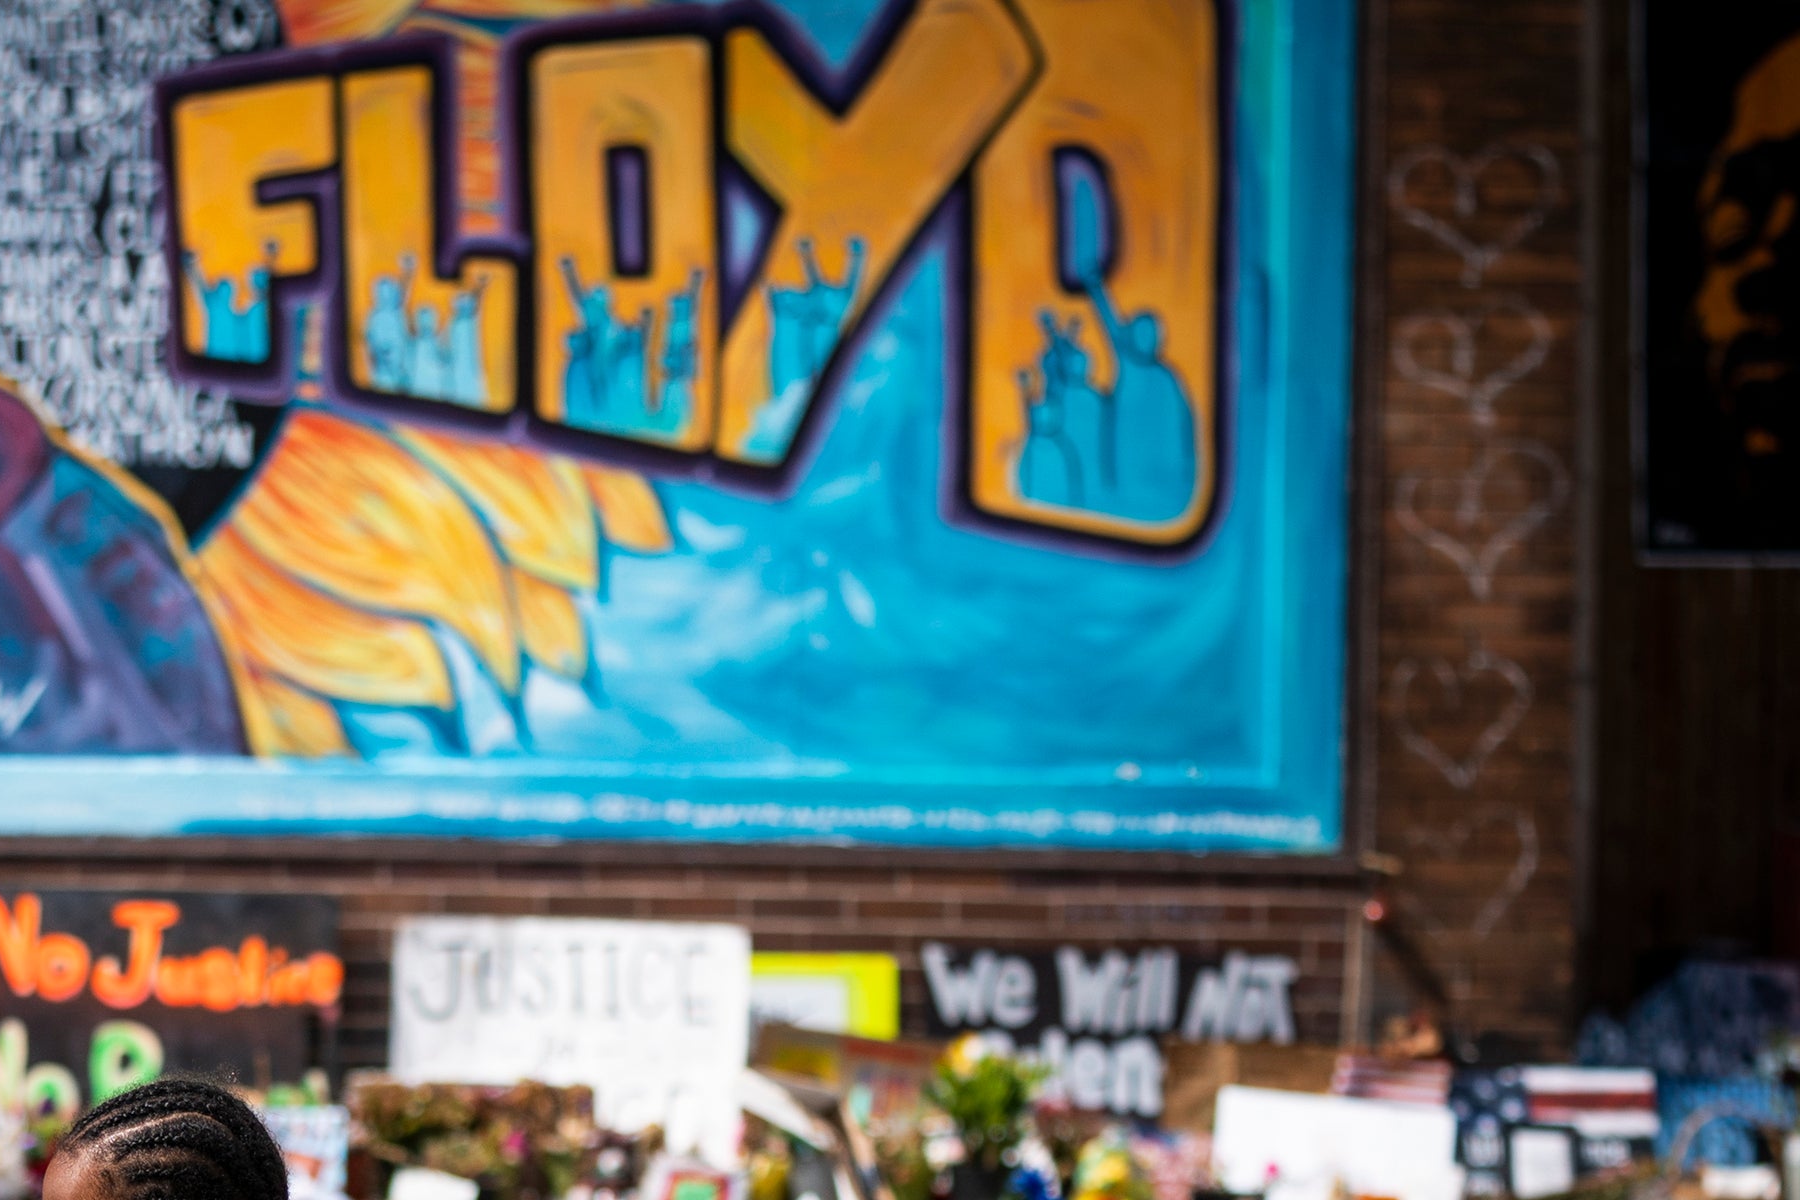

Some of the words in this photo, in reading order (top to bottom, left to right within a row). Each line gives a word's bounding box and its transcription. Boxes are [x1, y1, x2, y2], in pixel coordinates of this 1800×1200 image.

[173, 0, 1216, 544] FLOYD
[405, 932, 716, 1027] JUSTICE
[922, 941, 1038, 1030] We
[1054, 943, 1180, 1035] Will
